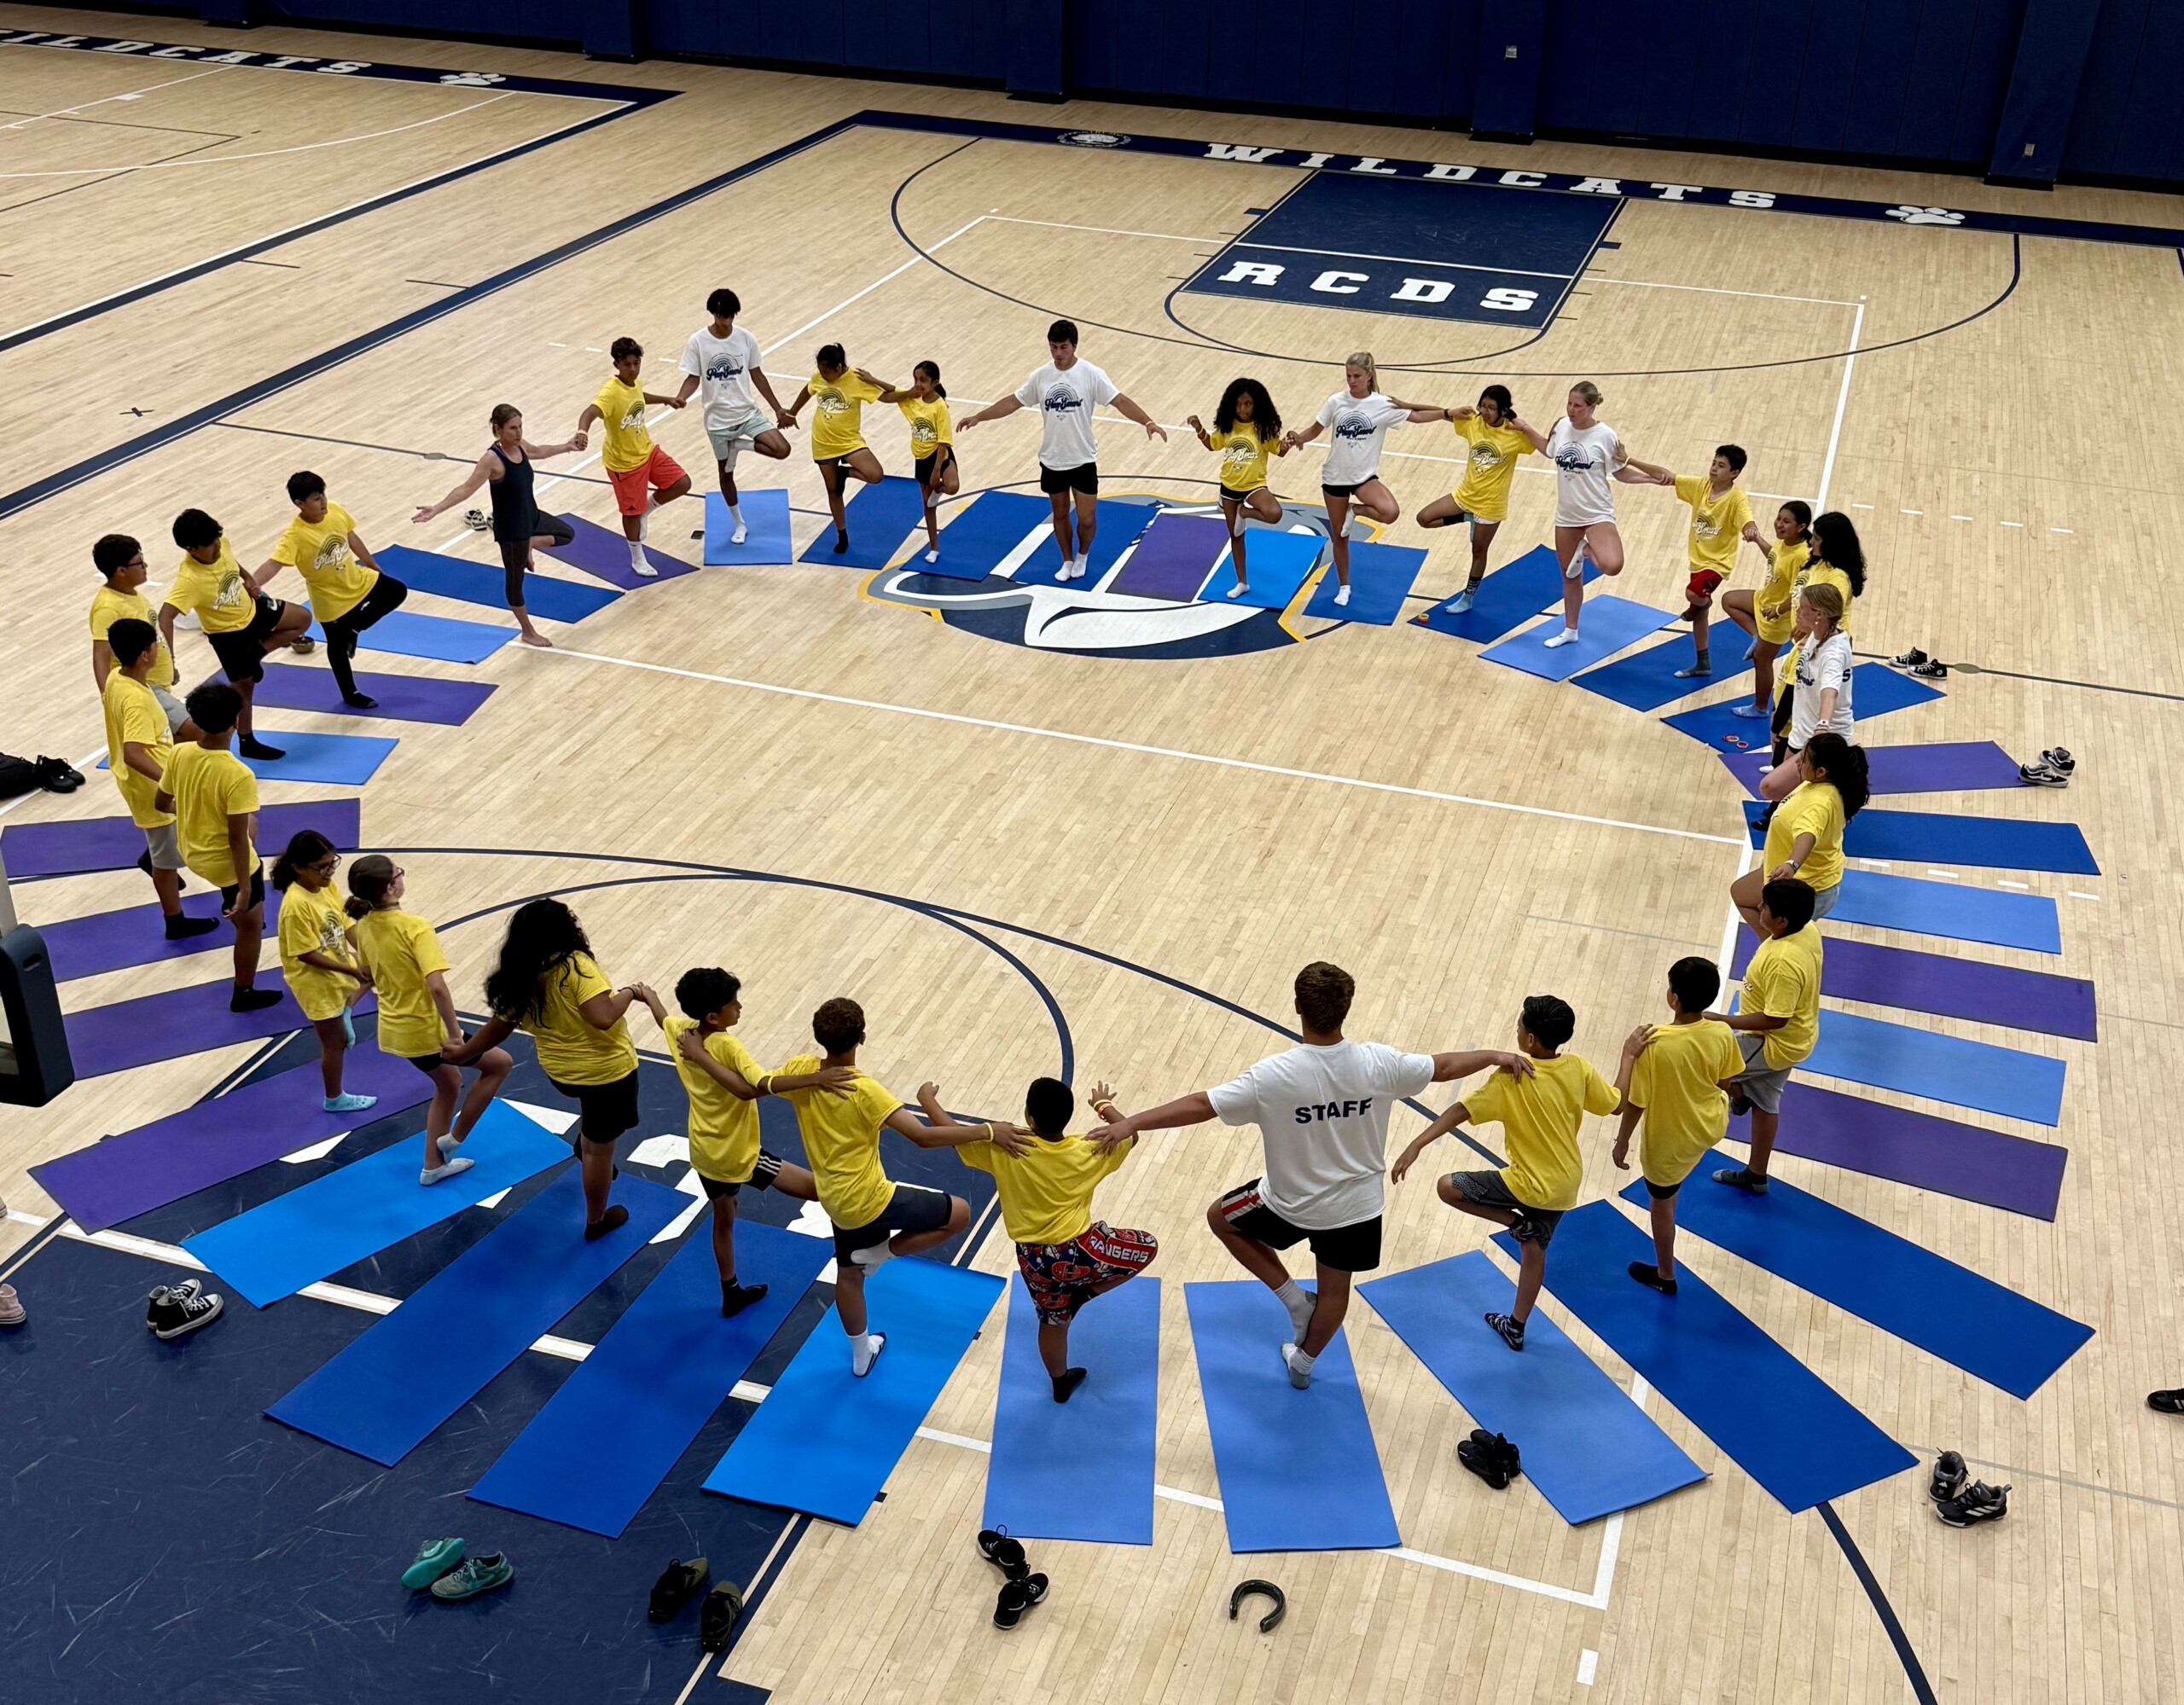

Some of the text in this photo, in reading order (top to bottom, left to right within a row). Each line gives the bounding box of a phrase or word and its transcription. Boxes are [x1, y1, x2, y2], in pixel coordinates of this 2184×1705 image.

[0, 30, 372, 73] ILDCATS
[1203, 143, 1775, 208] WILDCATS
[1217, 261, 1538, 311] RCDS
[1295, 1097, 1373, 1124] STAFF
